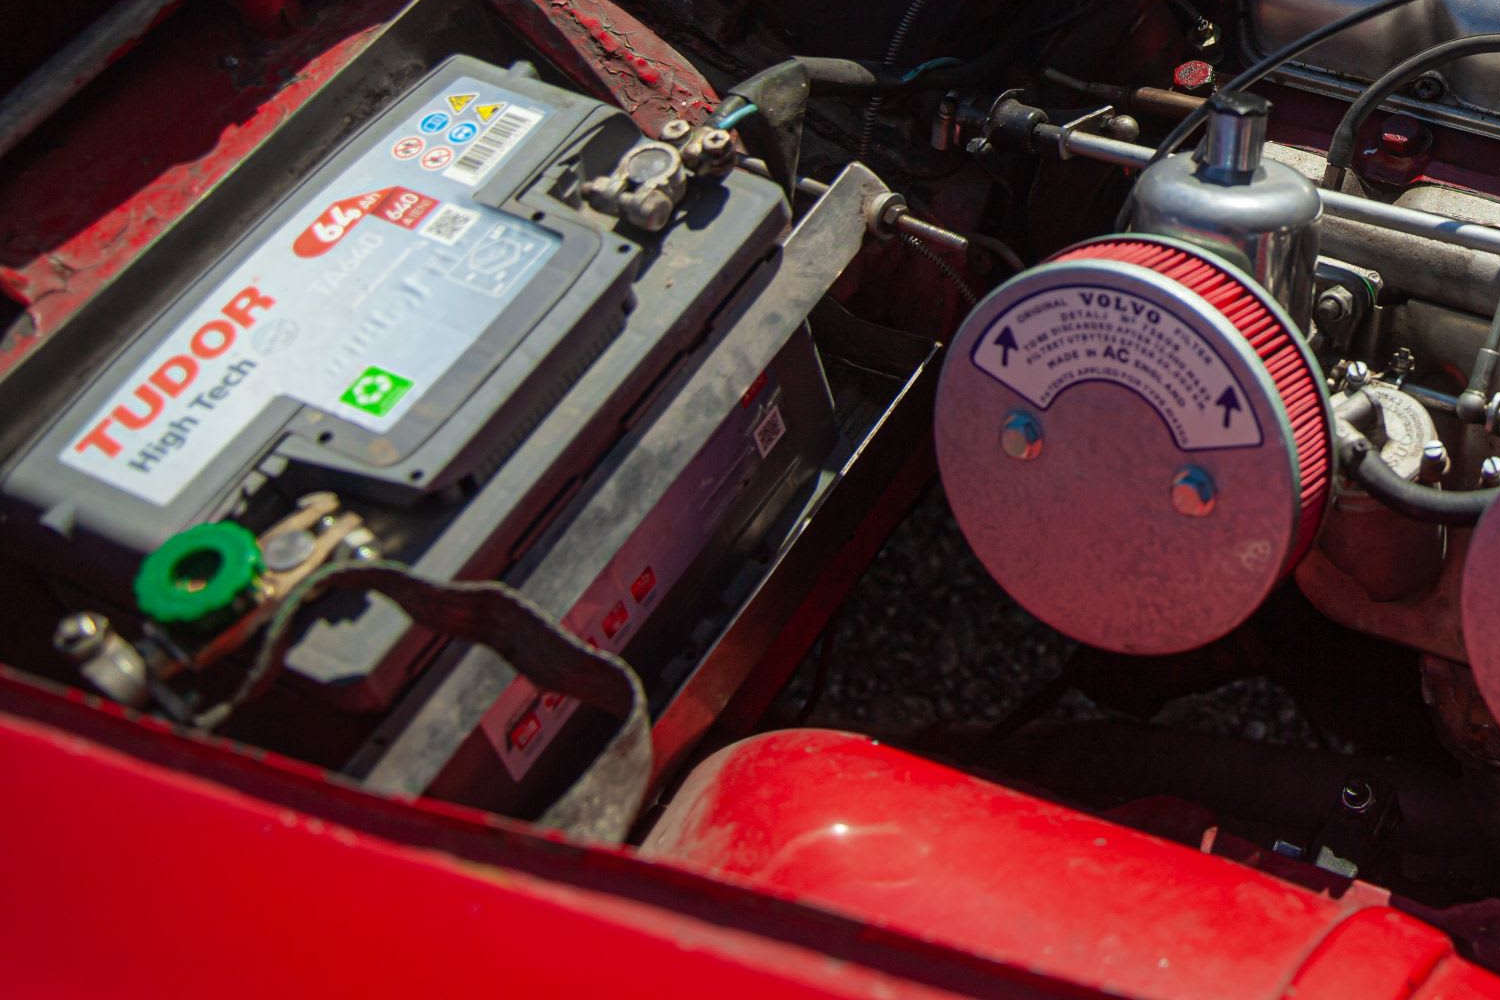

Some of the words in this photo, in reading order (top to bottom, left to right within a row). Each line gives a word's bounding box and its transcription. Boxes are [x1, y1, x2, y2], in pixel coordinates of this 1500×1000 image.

[312, 206, 362, 243] 64
[359, 193, 381, 210] Ah
[385, 193, 420, 220] 640
[1016, 298, 1067, 324] ORIGINAL
[1078, 292, 1161, 324] VOLVO
[1173, 327, 1213, 365] FILTER
[1047, 348, 1079, 370] MADE
[1102, 344, 1130, 364] AC
[74, 286, 279, 459] TUDOR
[127, 414, 202, 474] High
[188, 358, 258, 413] Tech
